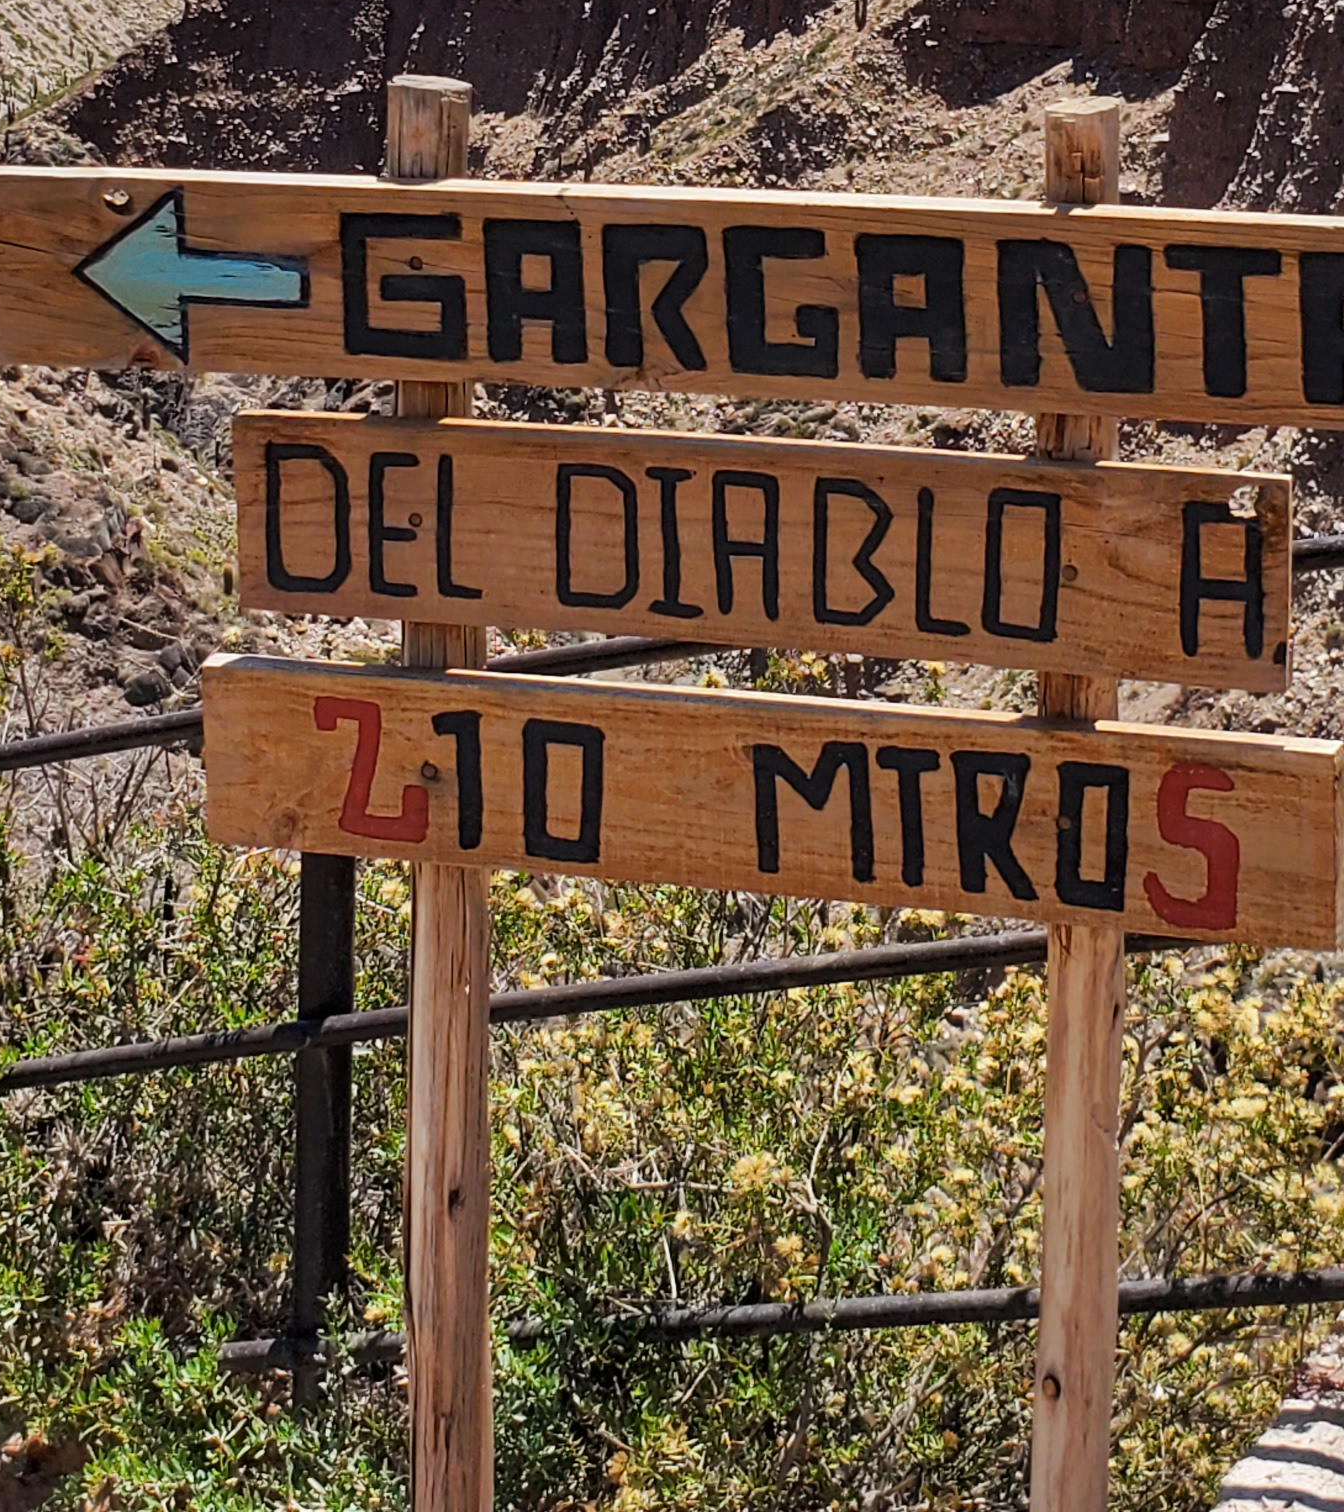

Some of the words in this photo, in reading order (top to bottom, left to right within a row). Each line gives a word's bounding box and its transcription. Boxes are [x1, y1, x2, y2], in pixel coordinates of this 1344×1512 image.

[264, 441, 483, 601] DEL
[555, 462, 1063, 644] DIABLO
[312, 695, 605, 864] 210
[752, 741, 1241, 932] MTROS
